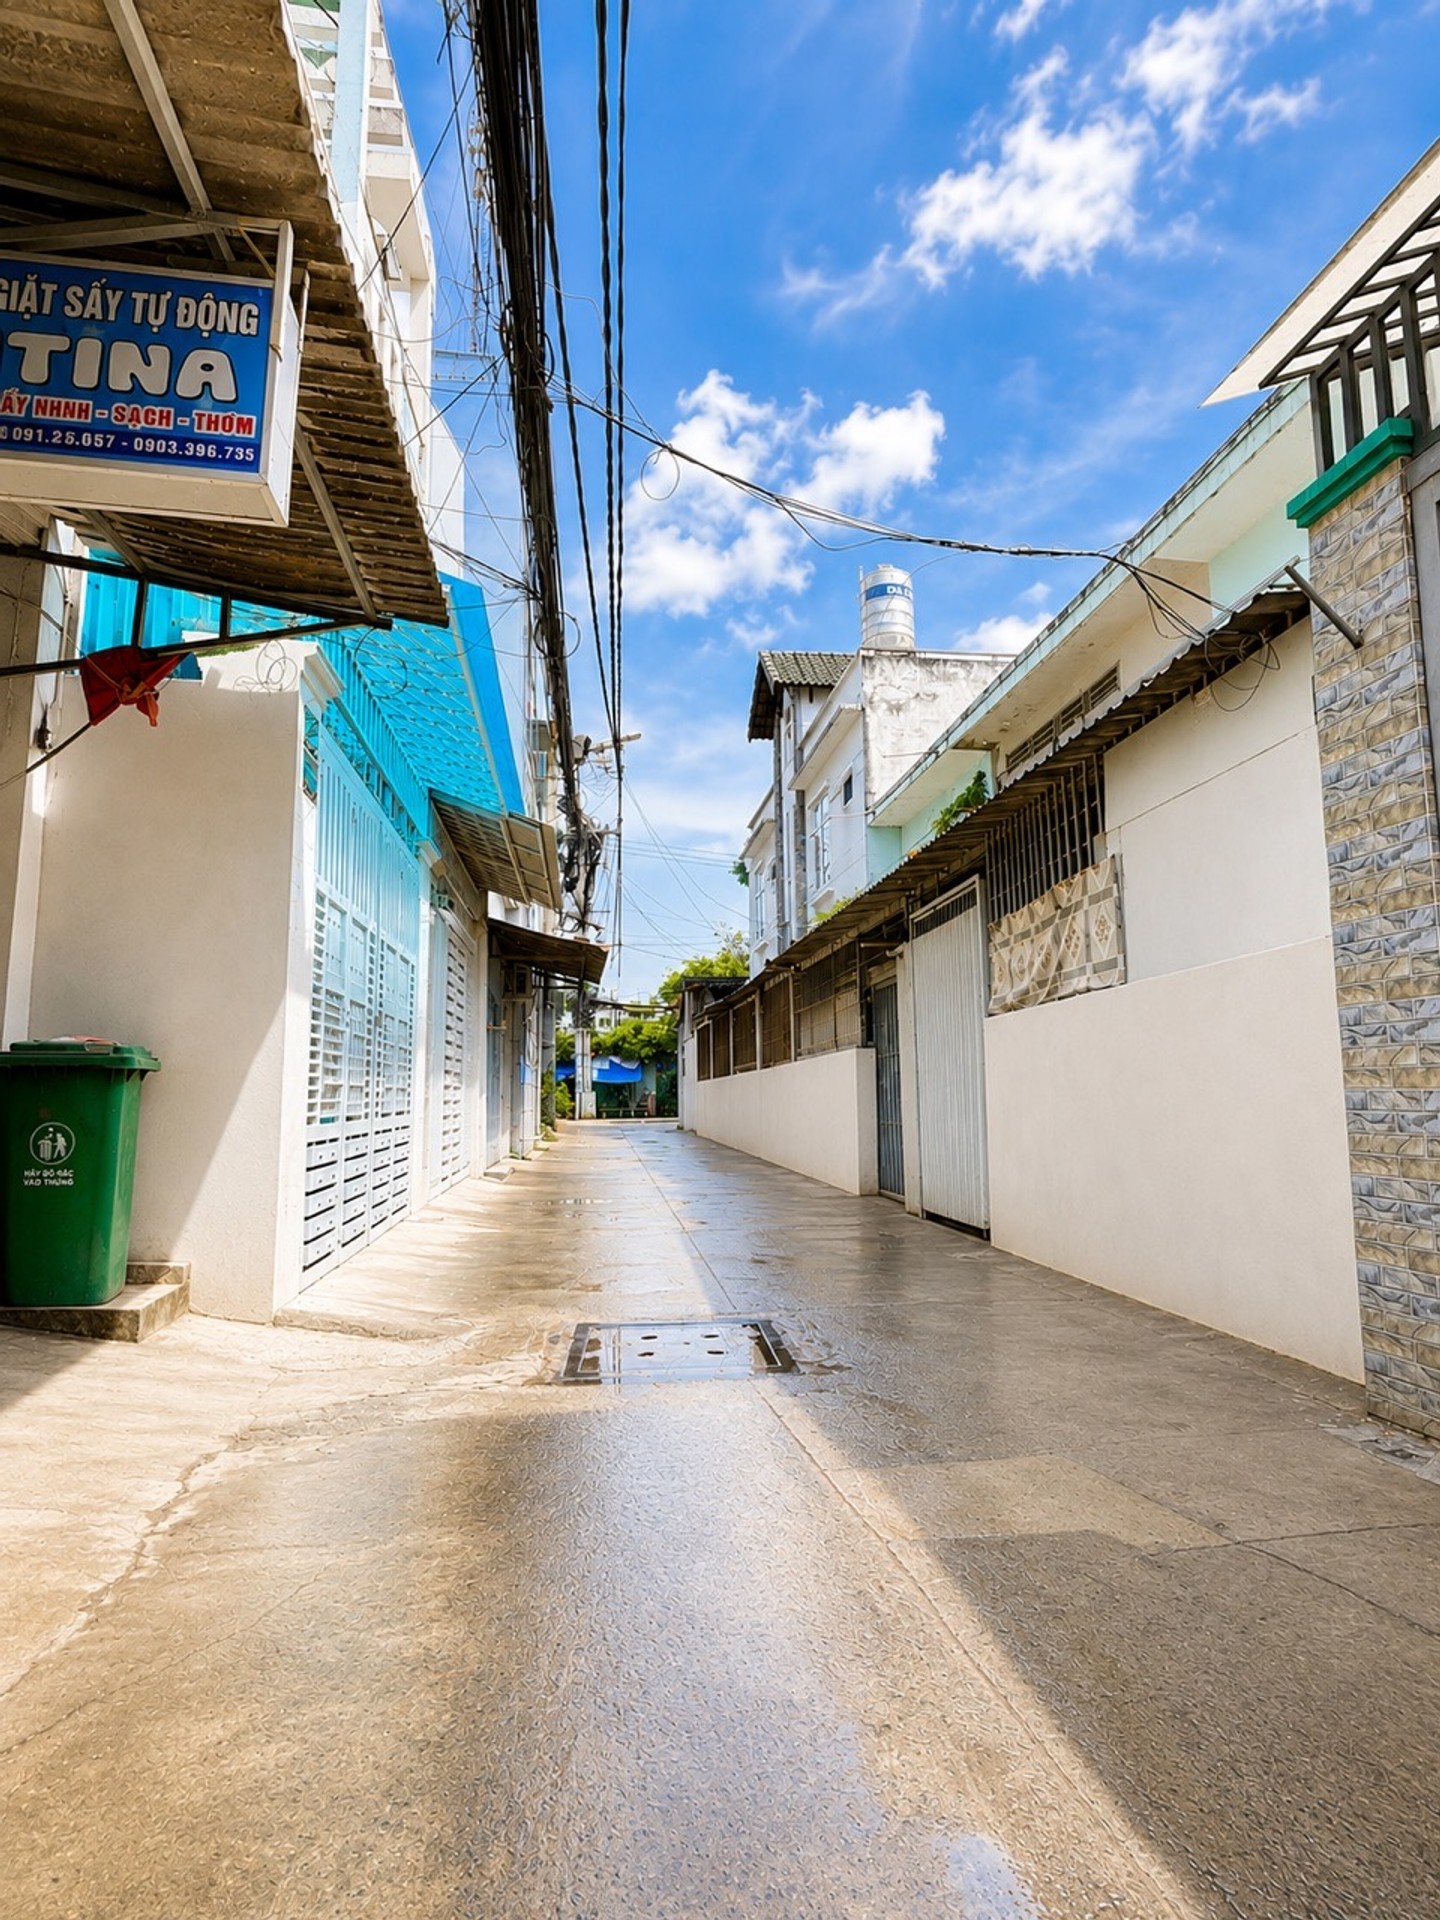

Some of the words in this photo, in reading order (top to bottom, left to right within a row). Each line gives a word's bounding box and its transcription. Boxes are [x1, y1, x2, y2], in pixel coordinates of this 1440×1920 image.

[64, 278, 124, 321] SẤY
[131, 291, 172, 333] TỰ
[176, 292, 259, 338] ĐỘNG
[7, 331, 237, 402] TINA
[112, 403, 173, 430] SẠCH
[133, 437, 255, 462] 0903.396.735
